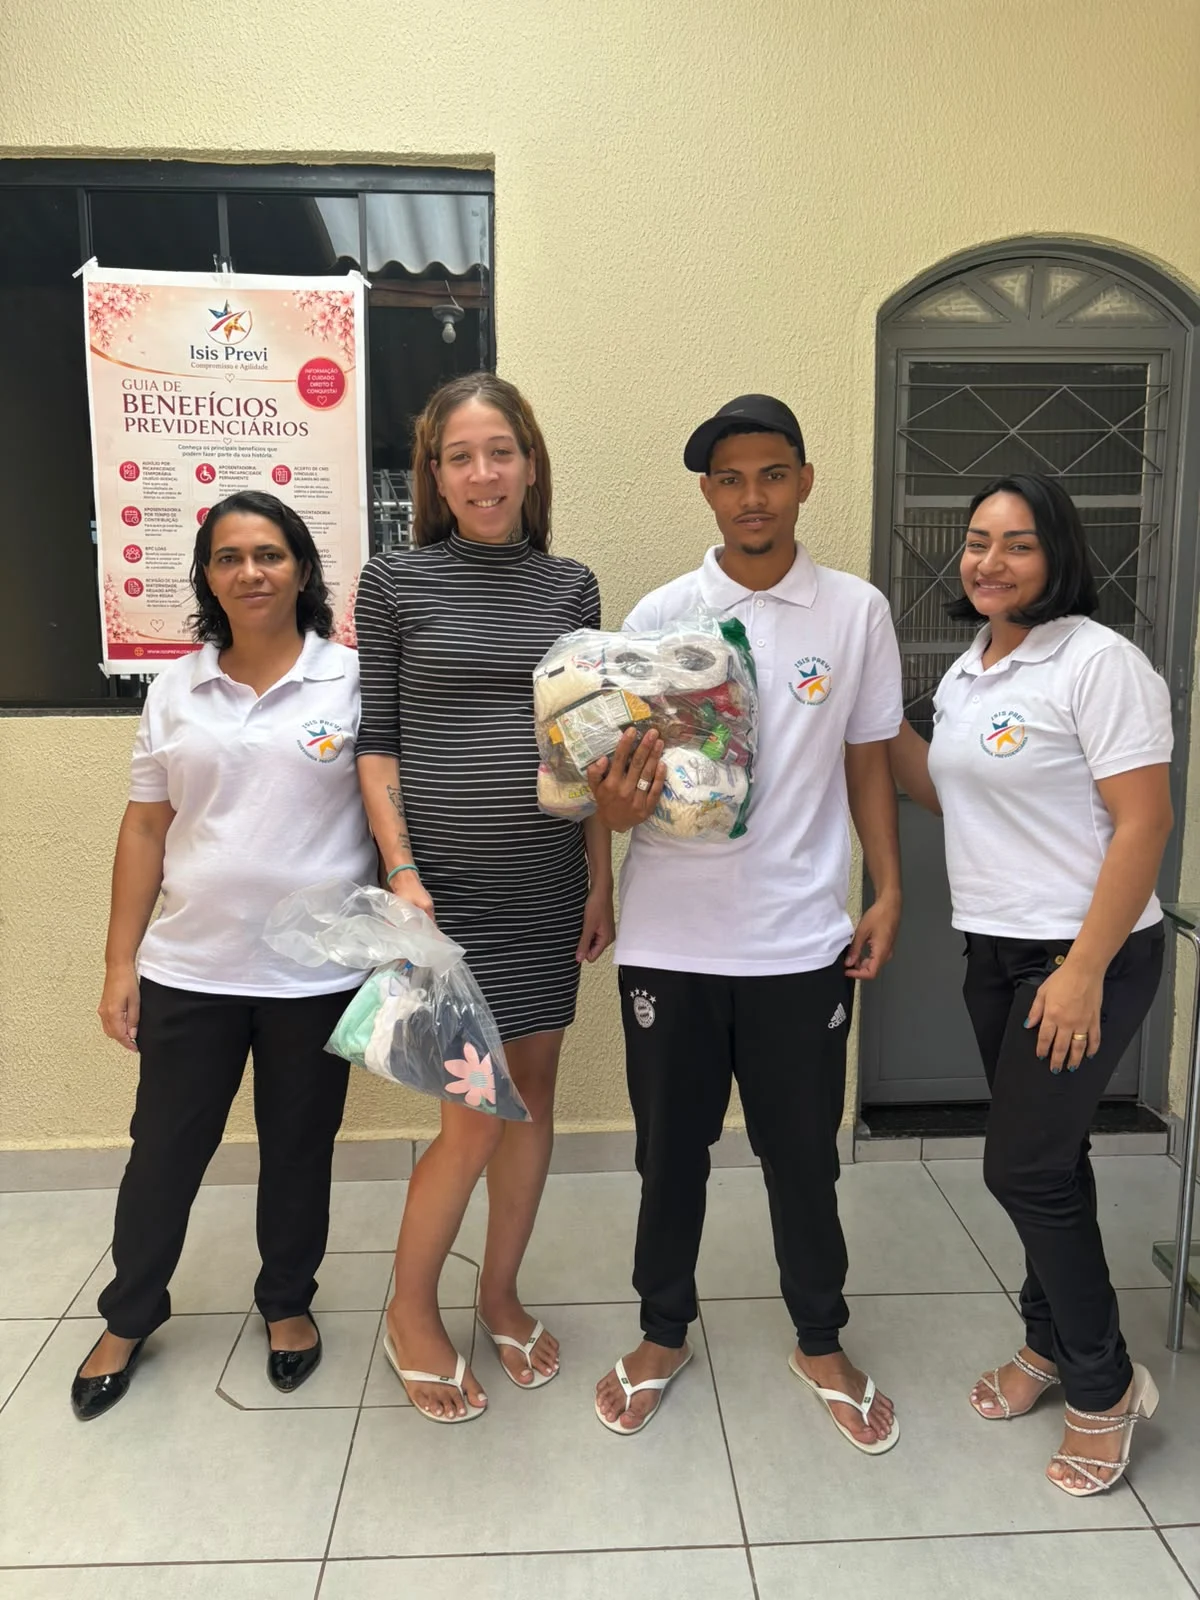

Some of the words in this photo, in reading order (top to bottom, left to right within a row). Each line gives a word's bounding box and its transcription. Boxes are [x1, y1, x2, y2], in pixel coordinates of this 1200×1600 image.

[190, 345, 219, 361] Isis
[225, 346, 268, 362] Previ
[190, 362, 234, 370] Compromisso
[240, 363, 269, 371] Agilidade
[121, 378, 159, 392] GUIA
[163, 380, 182, 392] DE
[122, 391, 278, 418] BENEFÍCIOS
[124, 417, 309, 437] PREVIDENCIÁRIOS
[177, 444, 202, 452] Conheça
[794, 656, 810, 669] ISIS
[811, 656, 832, 672] PREVI
[990, 711, 1007, 721] ISIS
[1008, 710, 1026, 723] PREV
[301, 719, 318, 729] ISIS
[319, 719, 342, 732] PREVI
